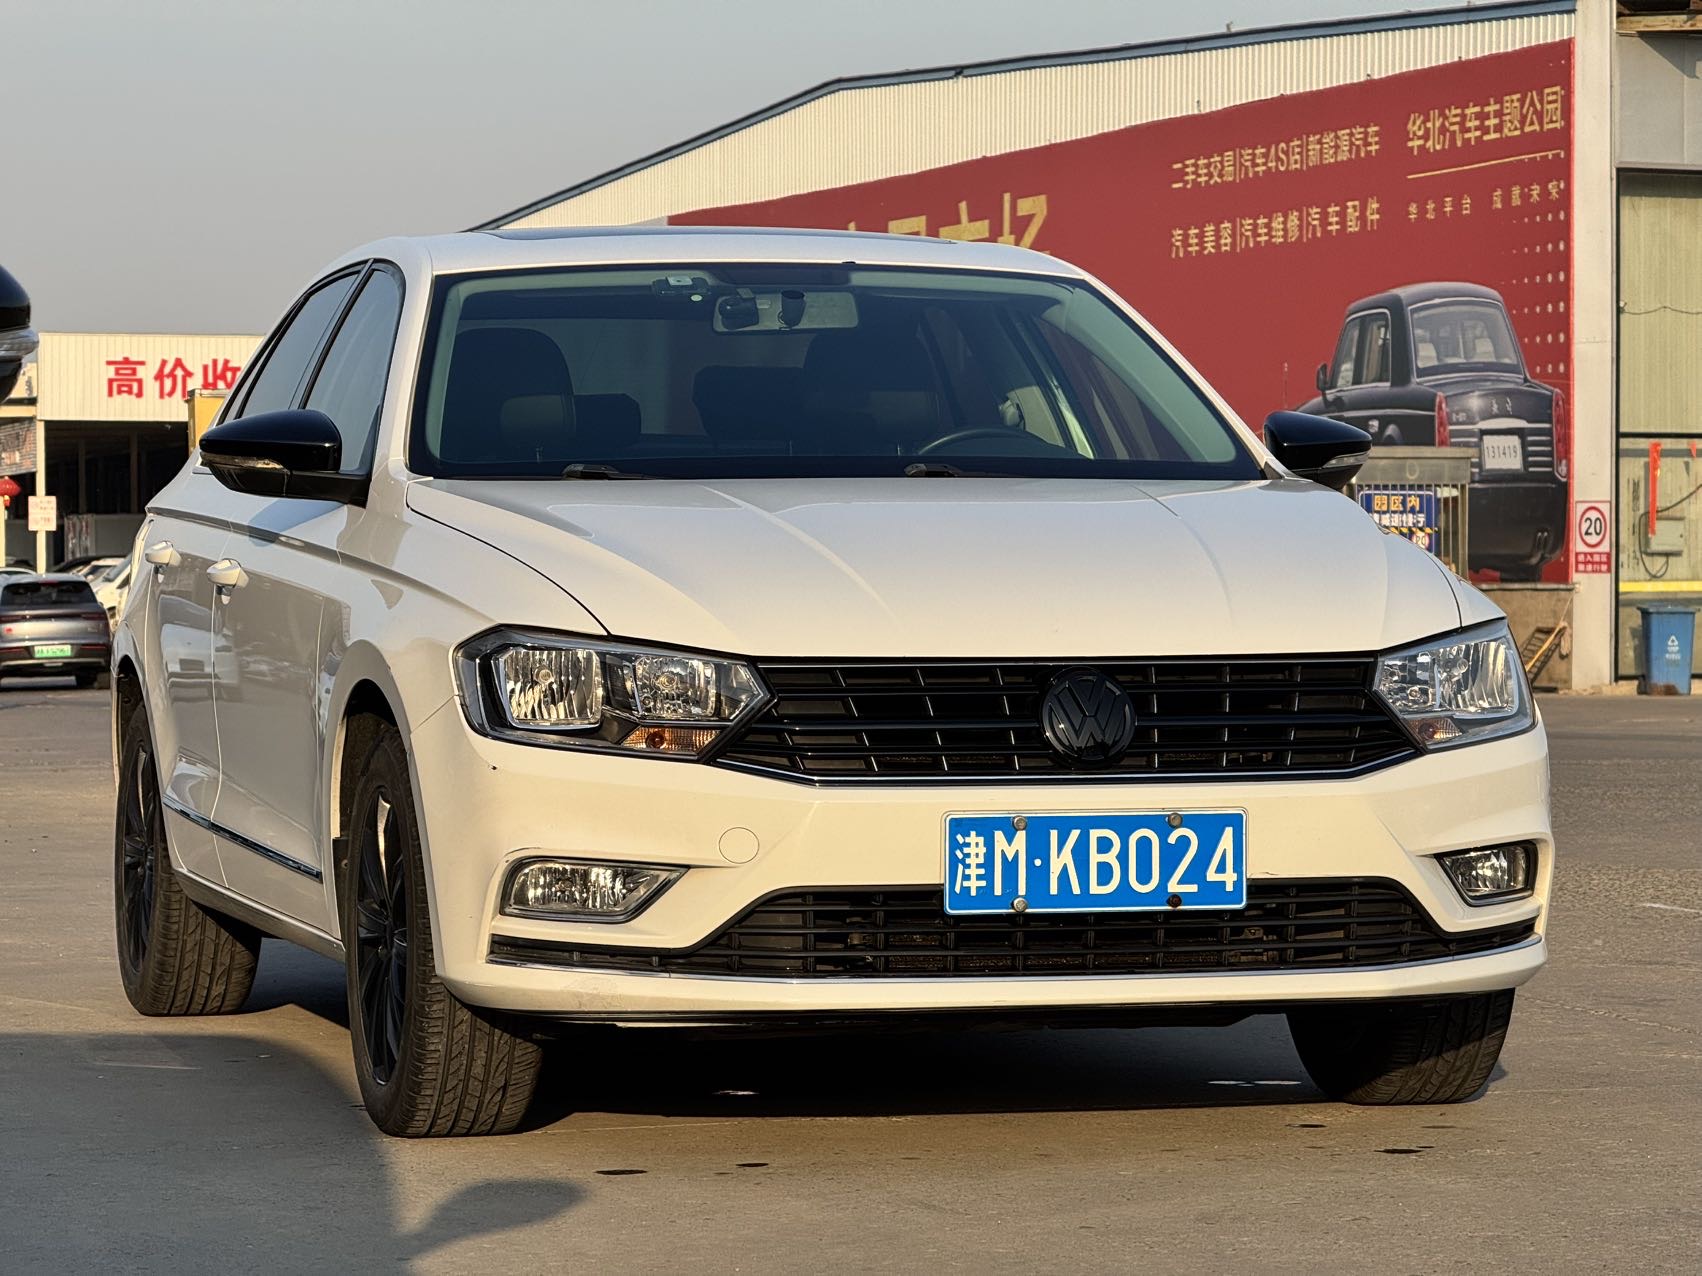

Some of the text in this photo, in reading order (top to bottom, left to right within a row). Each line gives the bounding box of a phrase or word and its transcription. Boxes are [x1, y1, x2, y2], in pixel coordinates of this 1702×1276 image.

[1407, 86, 1561, 156] 华北汽车主题公园
[1408, 194, 1472, 222] 华北平台
[105, 356, 241, 400] 高价收
[1486, 445, 1519, 459] 131419
[1584, 517, 1603, 536] 20
[954, 826, 1238, 896] 津M·KB024
